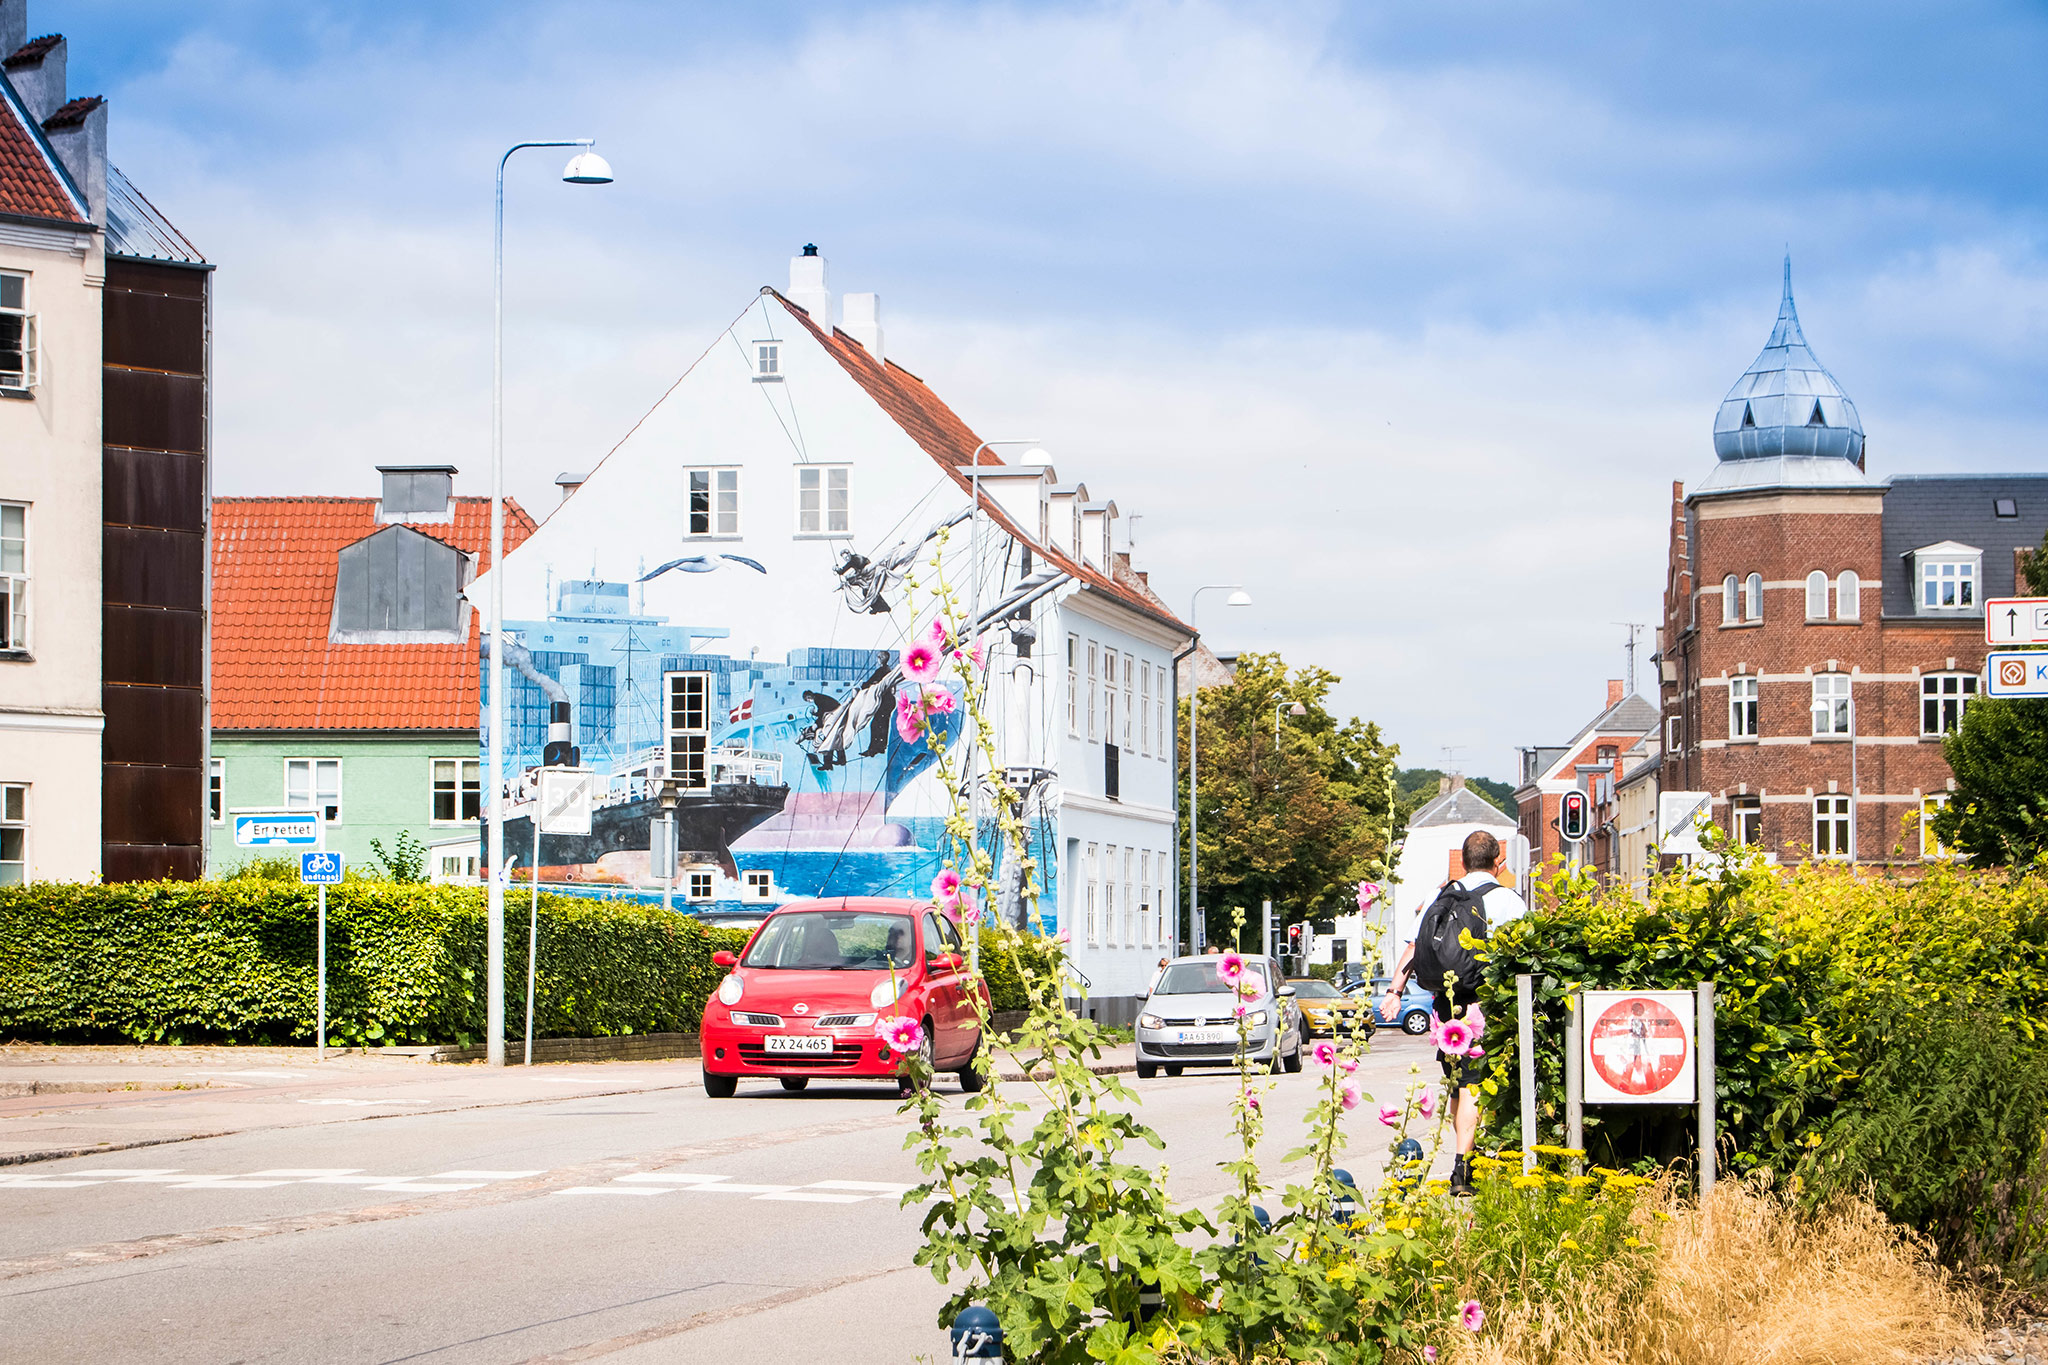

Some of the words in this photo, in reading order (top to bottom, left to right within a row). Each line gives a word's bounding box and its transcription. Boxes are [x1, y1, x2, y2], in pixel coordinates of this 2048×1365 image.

[1183, 1033, 1194, 1041] AA
[1195, 1033, 1205, 1041] 63
[1206, 1032, 1221, 1041] 890
[771, 1039, 786, 1050] ZX
[789, 1039, 803, 1050] 24
[806, 1039, 827, 1050] 465
